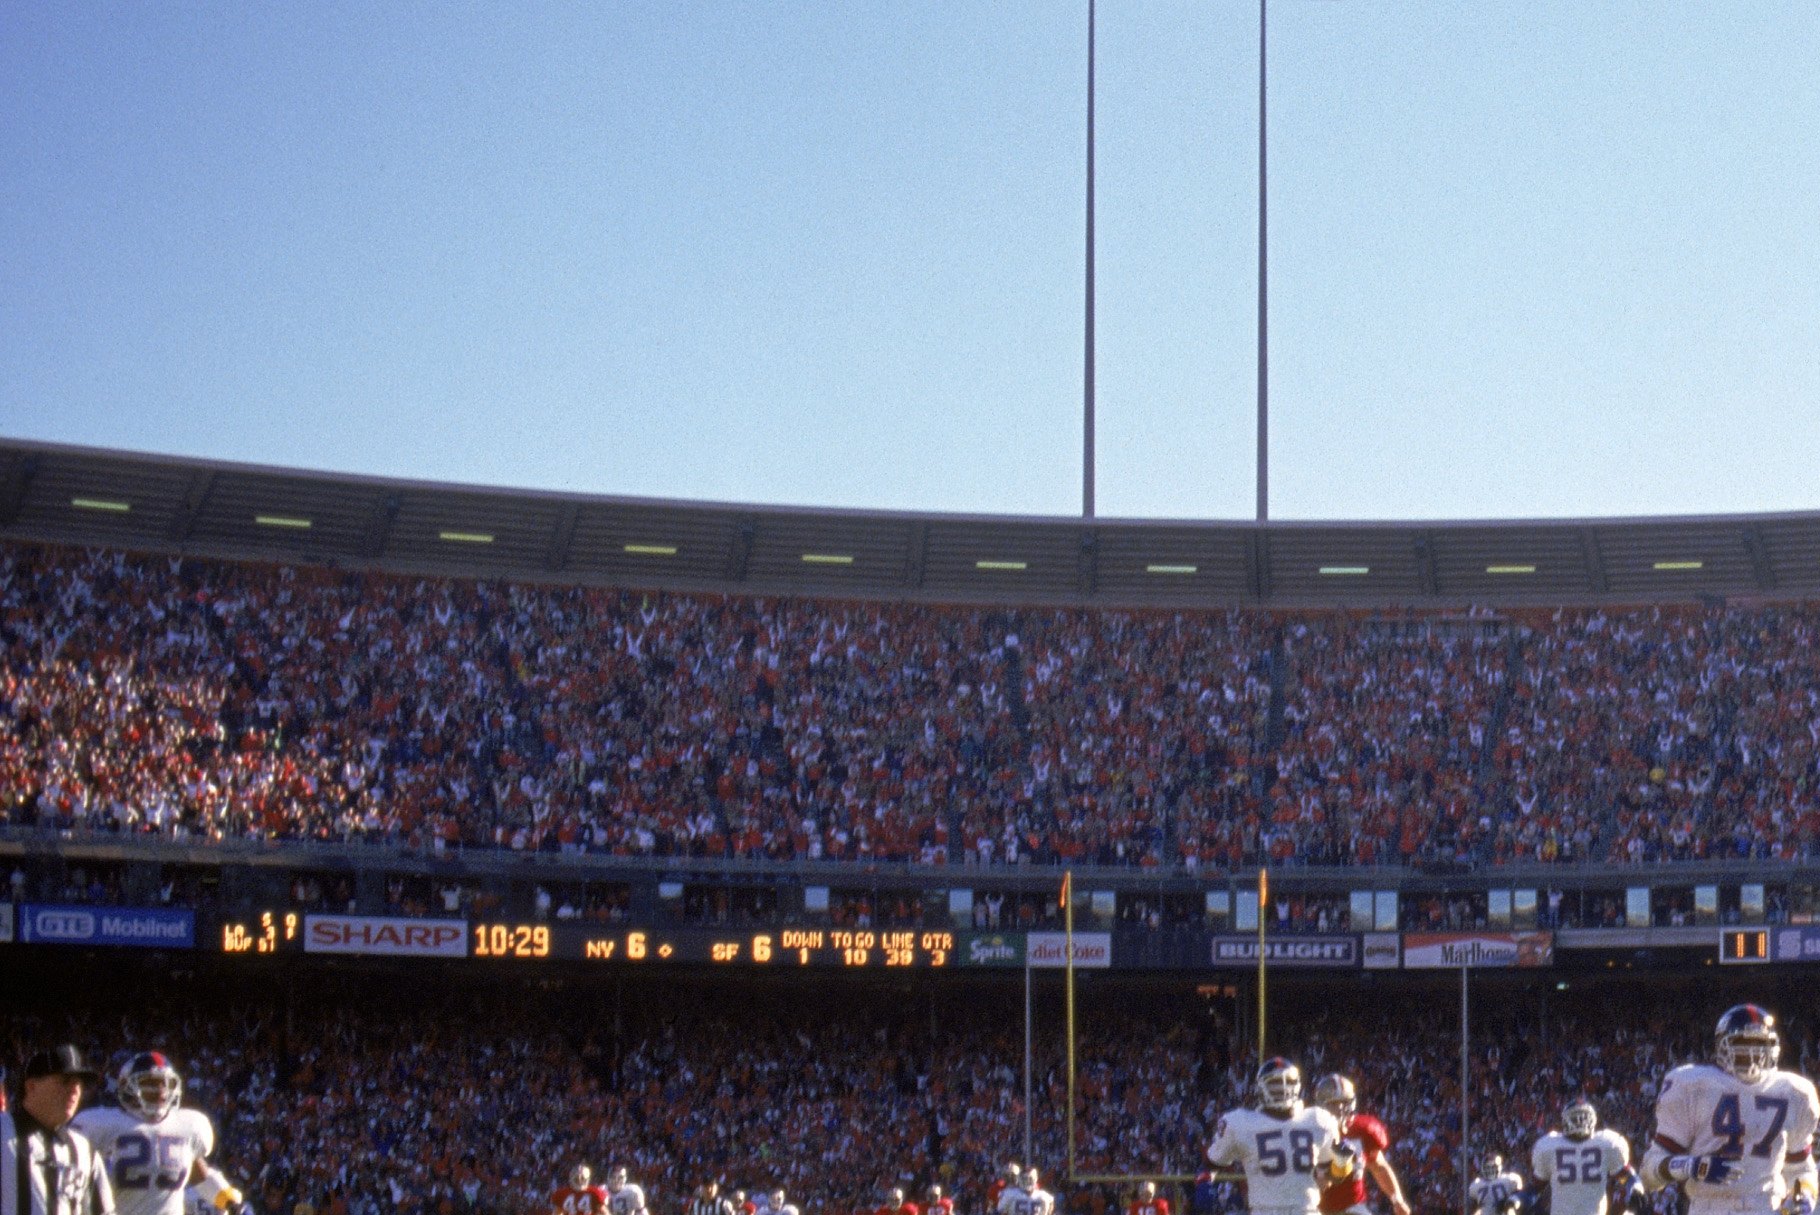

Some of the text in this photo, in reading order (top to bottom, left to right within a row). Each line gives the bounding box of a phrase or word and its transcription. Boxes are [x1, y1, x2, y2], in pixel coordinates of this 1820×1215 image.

[102, 916, 187, 938] Mobilnet
[312, 920, 461, 948] SHARP
[474, 923, 550, 957] 10:29
[782, 930, 823, 949] DOWN
[882, 932, 915, 950] LINE
[922, 932, 953, 950] QTR
[586, 932, 647, 959] NY 6
[712, 934, 772, 962] SF 6
[844, 948, 868, 966] 10
[930, 950, 945, 967] 3
[1219, 942, 1272, 959] BUD
[1273, 942, 1346, 959] LIGHT
[1712, 1093, 1788, 1160] 47
[115, 1133, 188, 1189] 25
[1256, 1129, 1314, 1177] 58
[1556, 1147, 1603, 1184] 52
